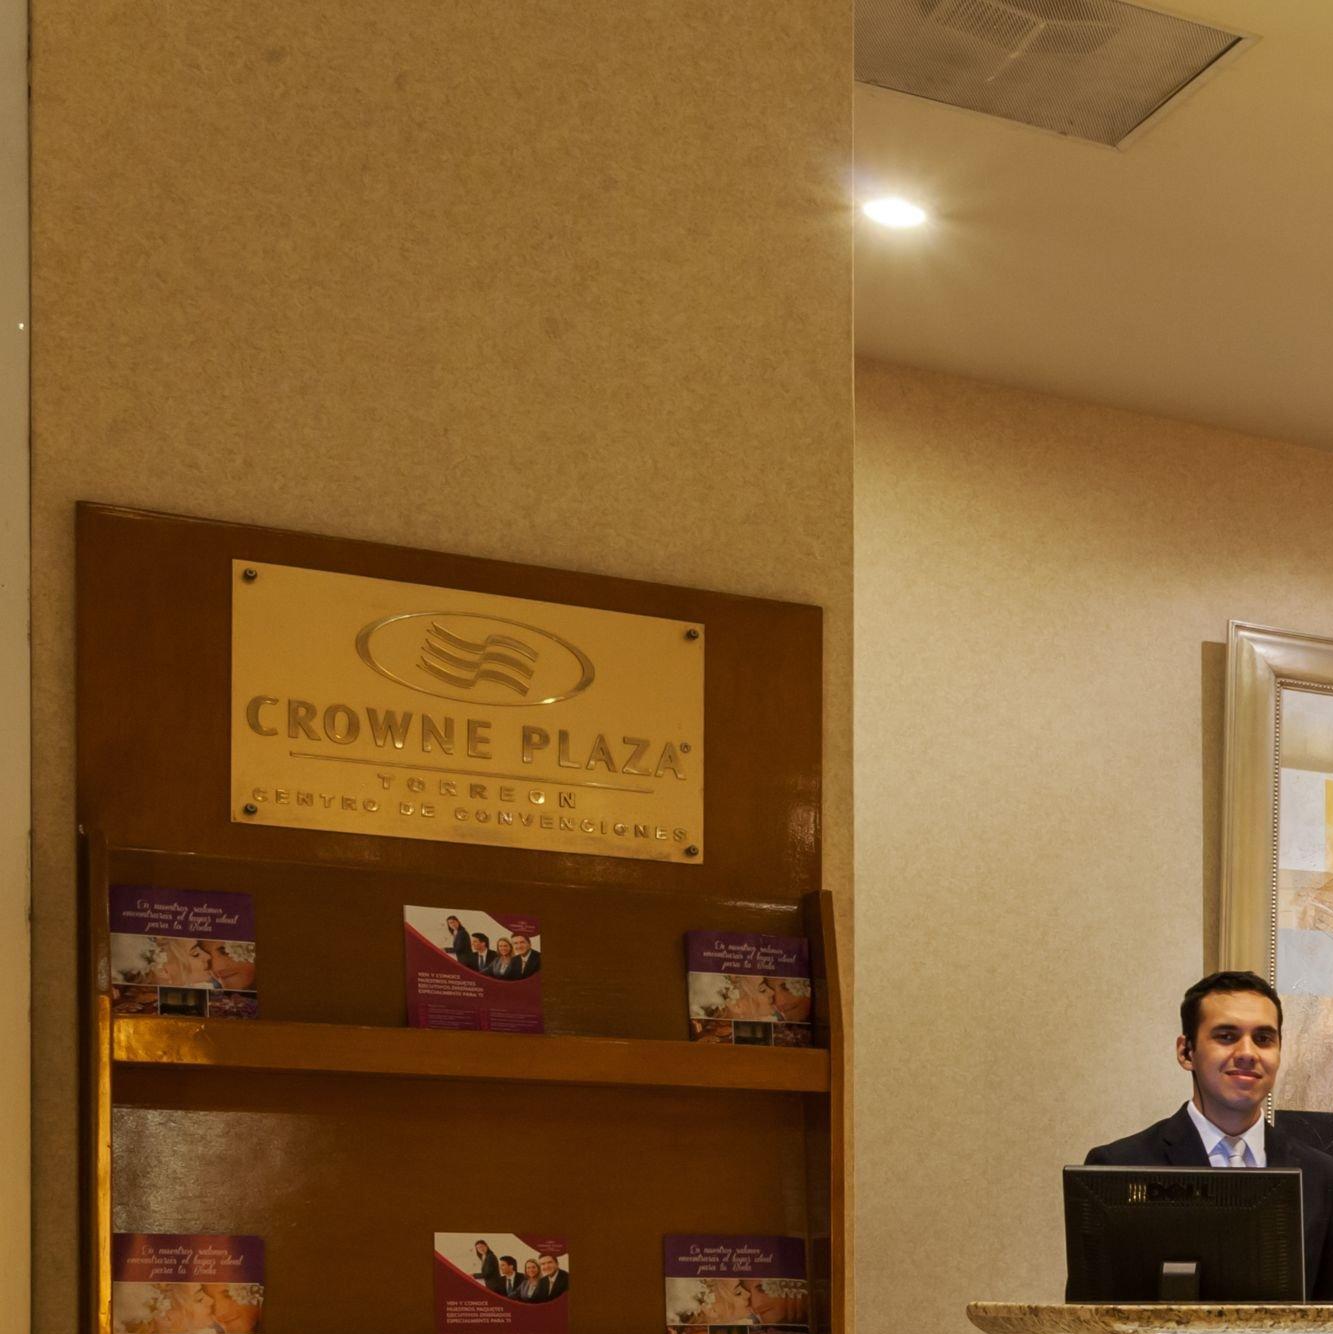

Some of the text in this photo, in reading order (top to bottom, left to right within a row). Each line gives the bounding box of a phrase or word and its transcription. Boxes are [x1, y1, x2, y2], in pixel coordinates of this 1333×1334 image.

[246, 695, 687, 781] CROWNE PLAZA
[252, 788, 688, 843] CENTRO DE CONVENCIONES
[377, 773, 577, 809] TORREON
